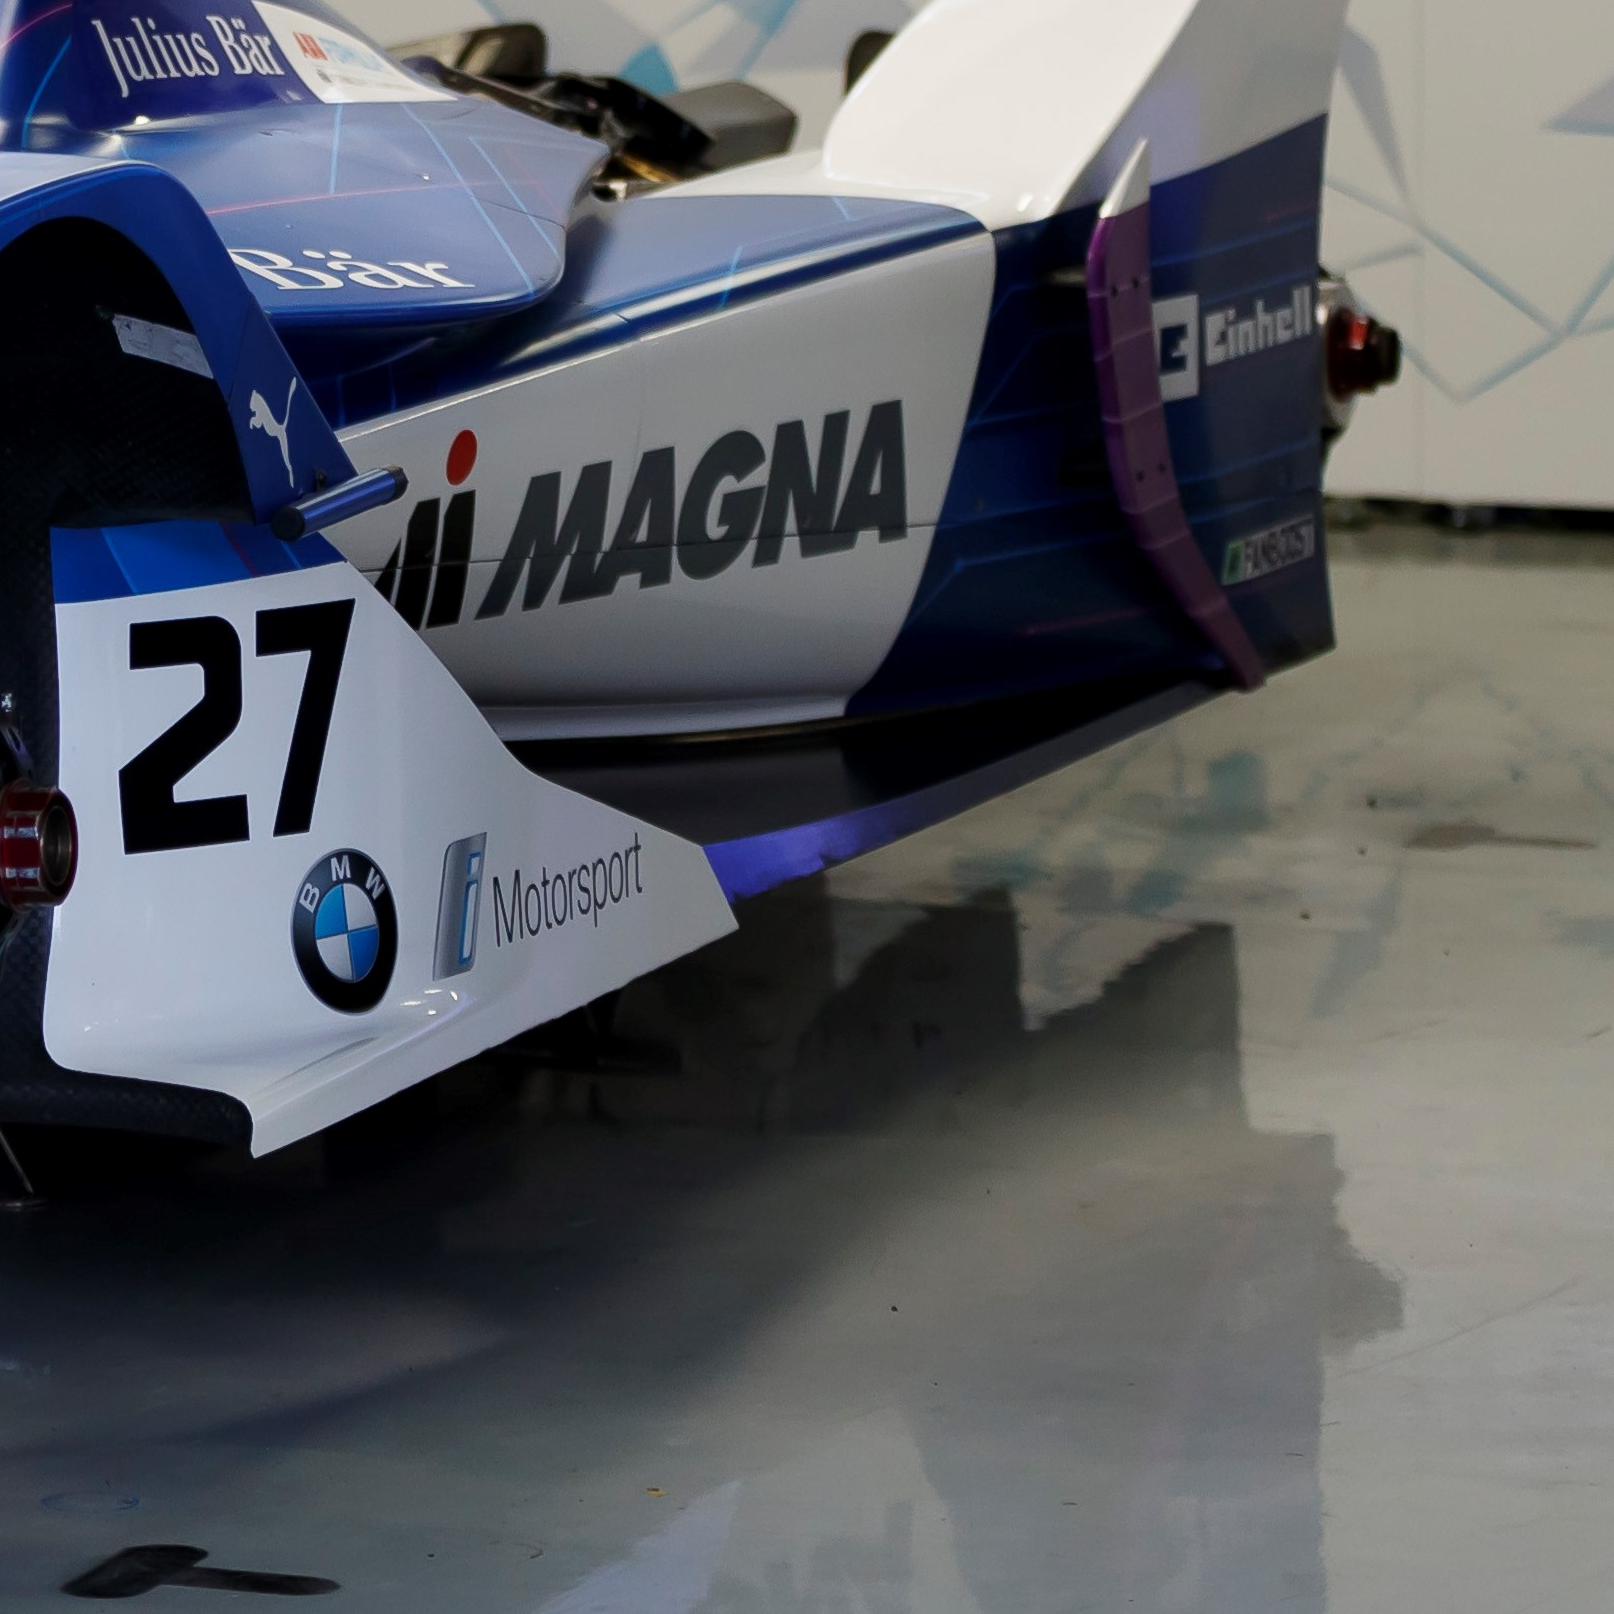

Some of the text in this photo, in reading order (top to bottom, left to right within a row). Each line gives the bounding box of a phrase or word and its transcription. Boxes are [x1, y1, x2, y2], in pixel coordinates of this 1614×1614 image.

[91, 15, 221, 98] Julius
[205, 15, 285, 76] Bär
[227, 248, 475, 291] Bär
[1205, 287, 1312, 367] Einhell
[474, 399, 909, 621] MAGNA
[118, 598, 356, 855] 27
[299, 854, 386, 915] BMW
[492, 831, 644, 948] Motorsport
